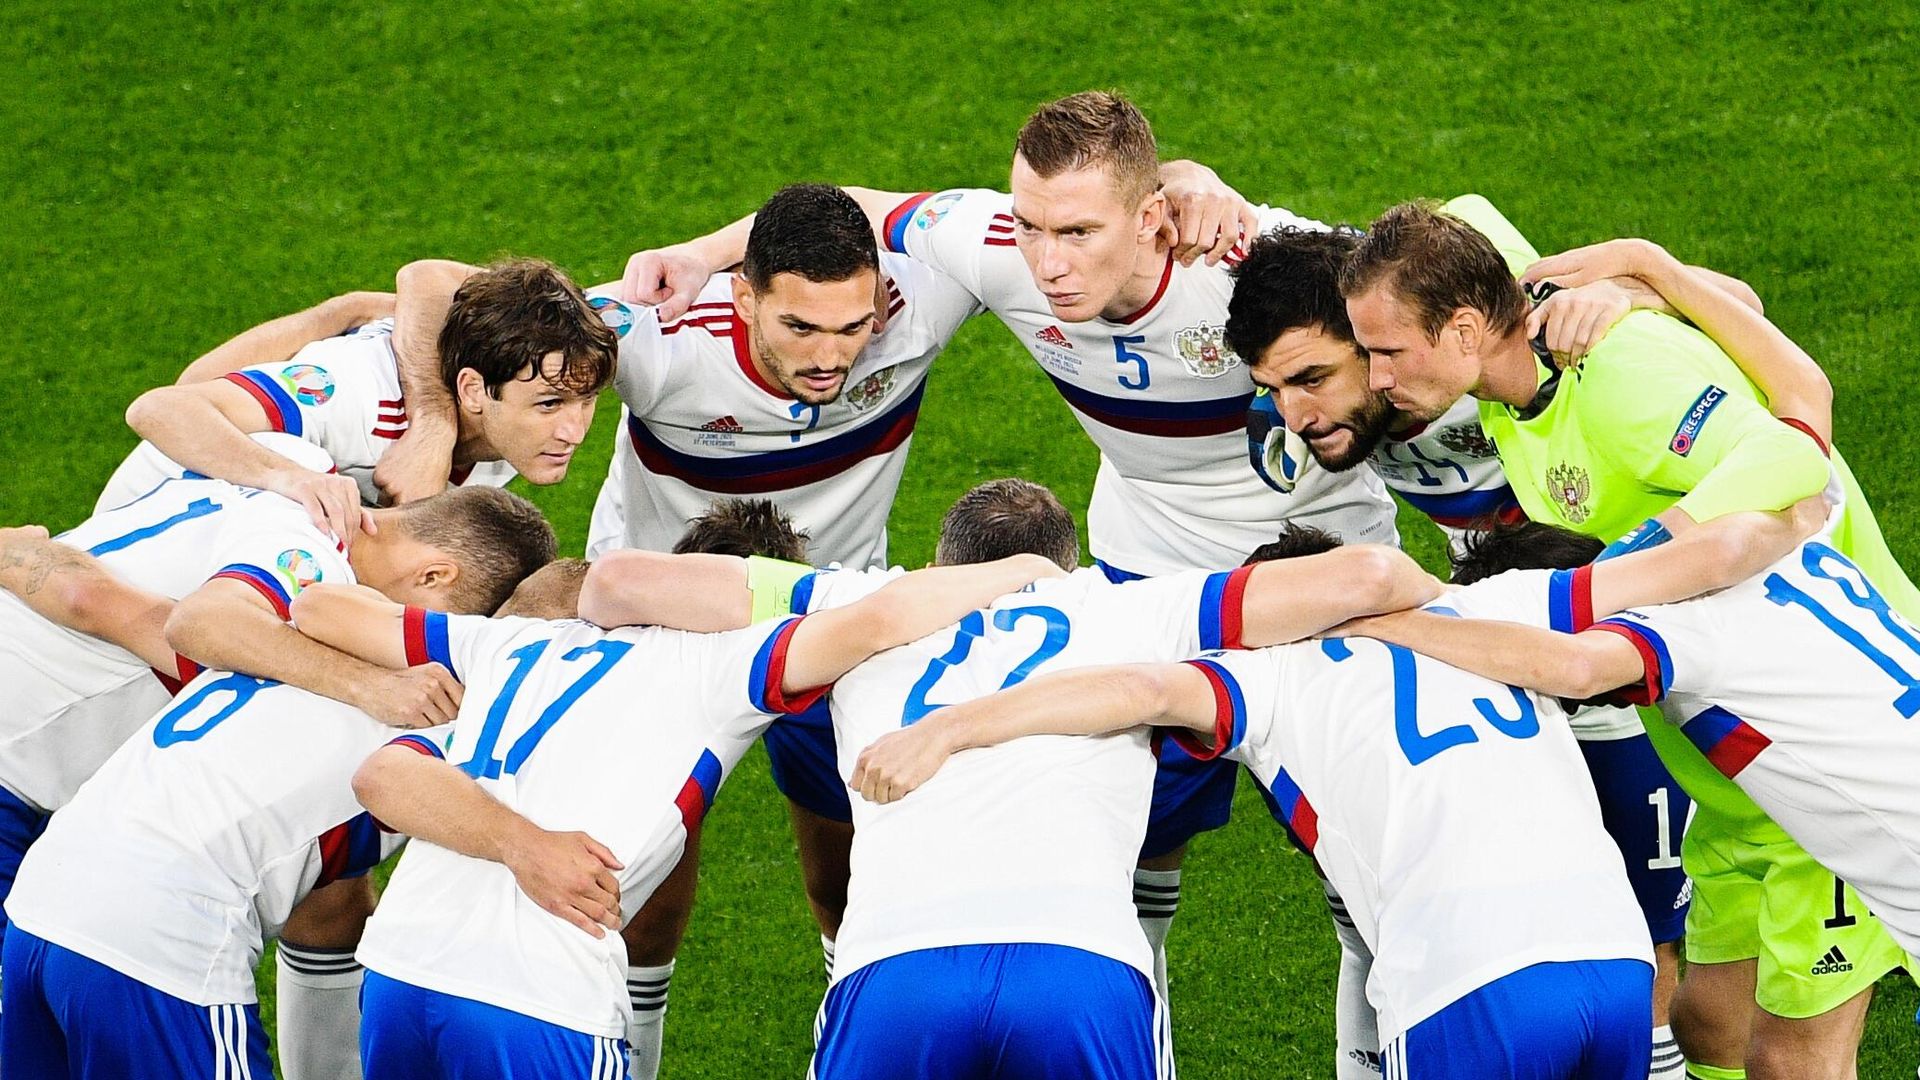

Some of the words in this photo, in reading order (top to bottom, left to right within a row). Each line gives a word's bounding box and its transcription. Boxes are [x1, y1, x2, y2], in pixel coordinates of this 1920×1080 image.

[1035, 330, 1073, 349] adidas
[1112, 335, 1151, 390] 5
[788, 402, 820, 443] 7
[1684, 387, 1721, 434] RESPECT
[454, 639, 635, 780] 17
[1811, 963, 1853, 975] adidas
